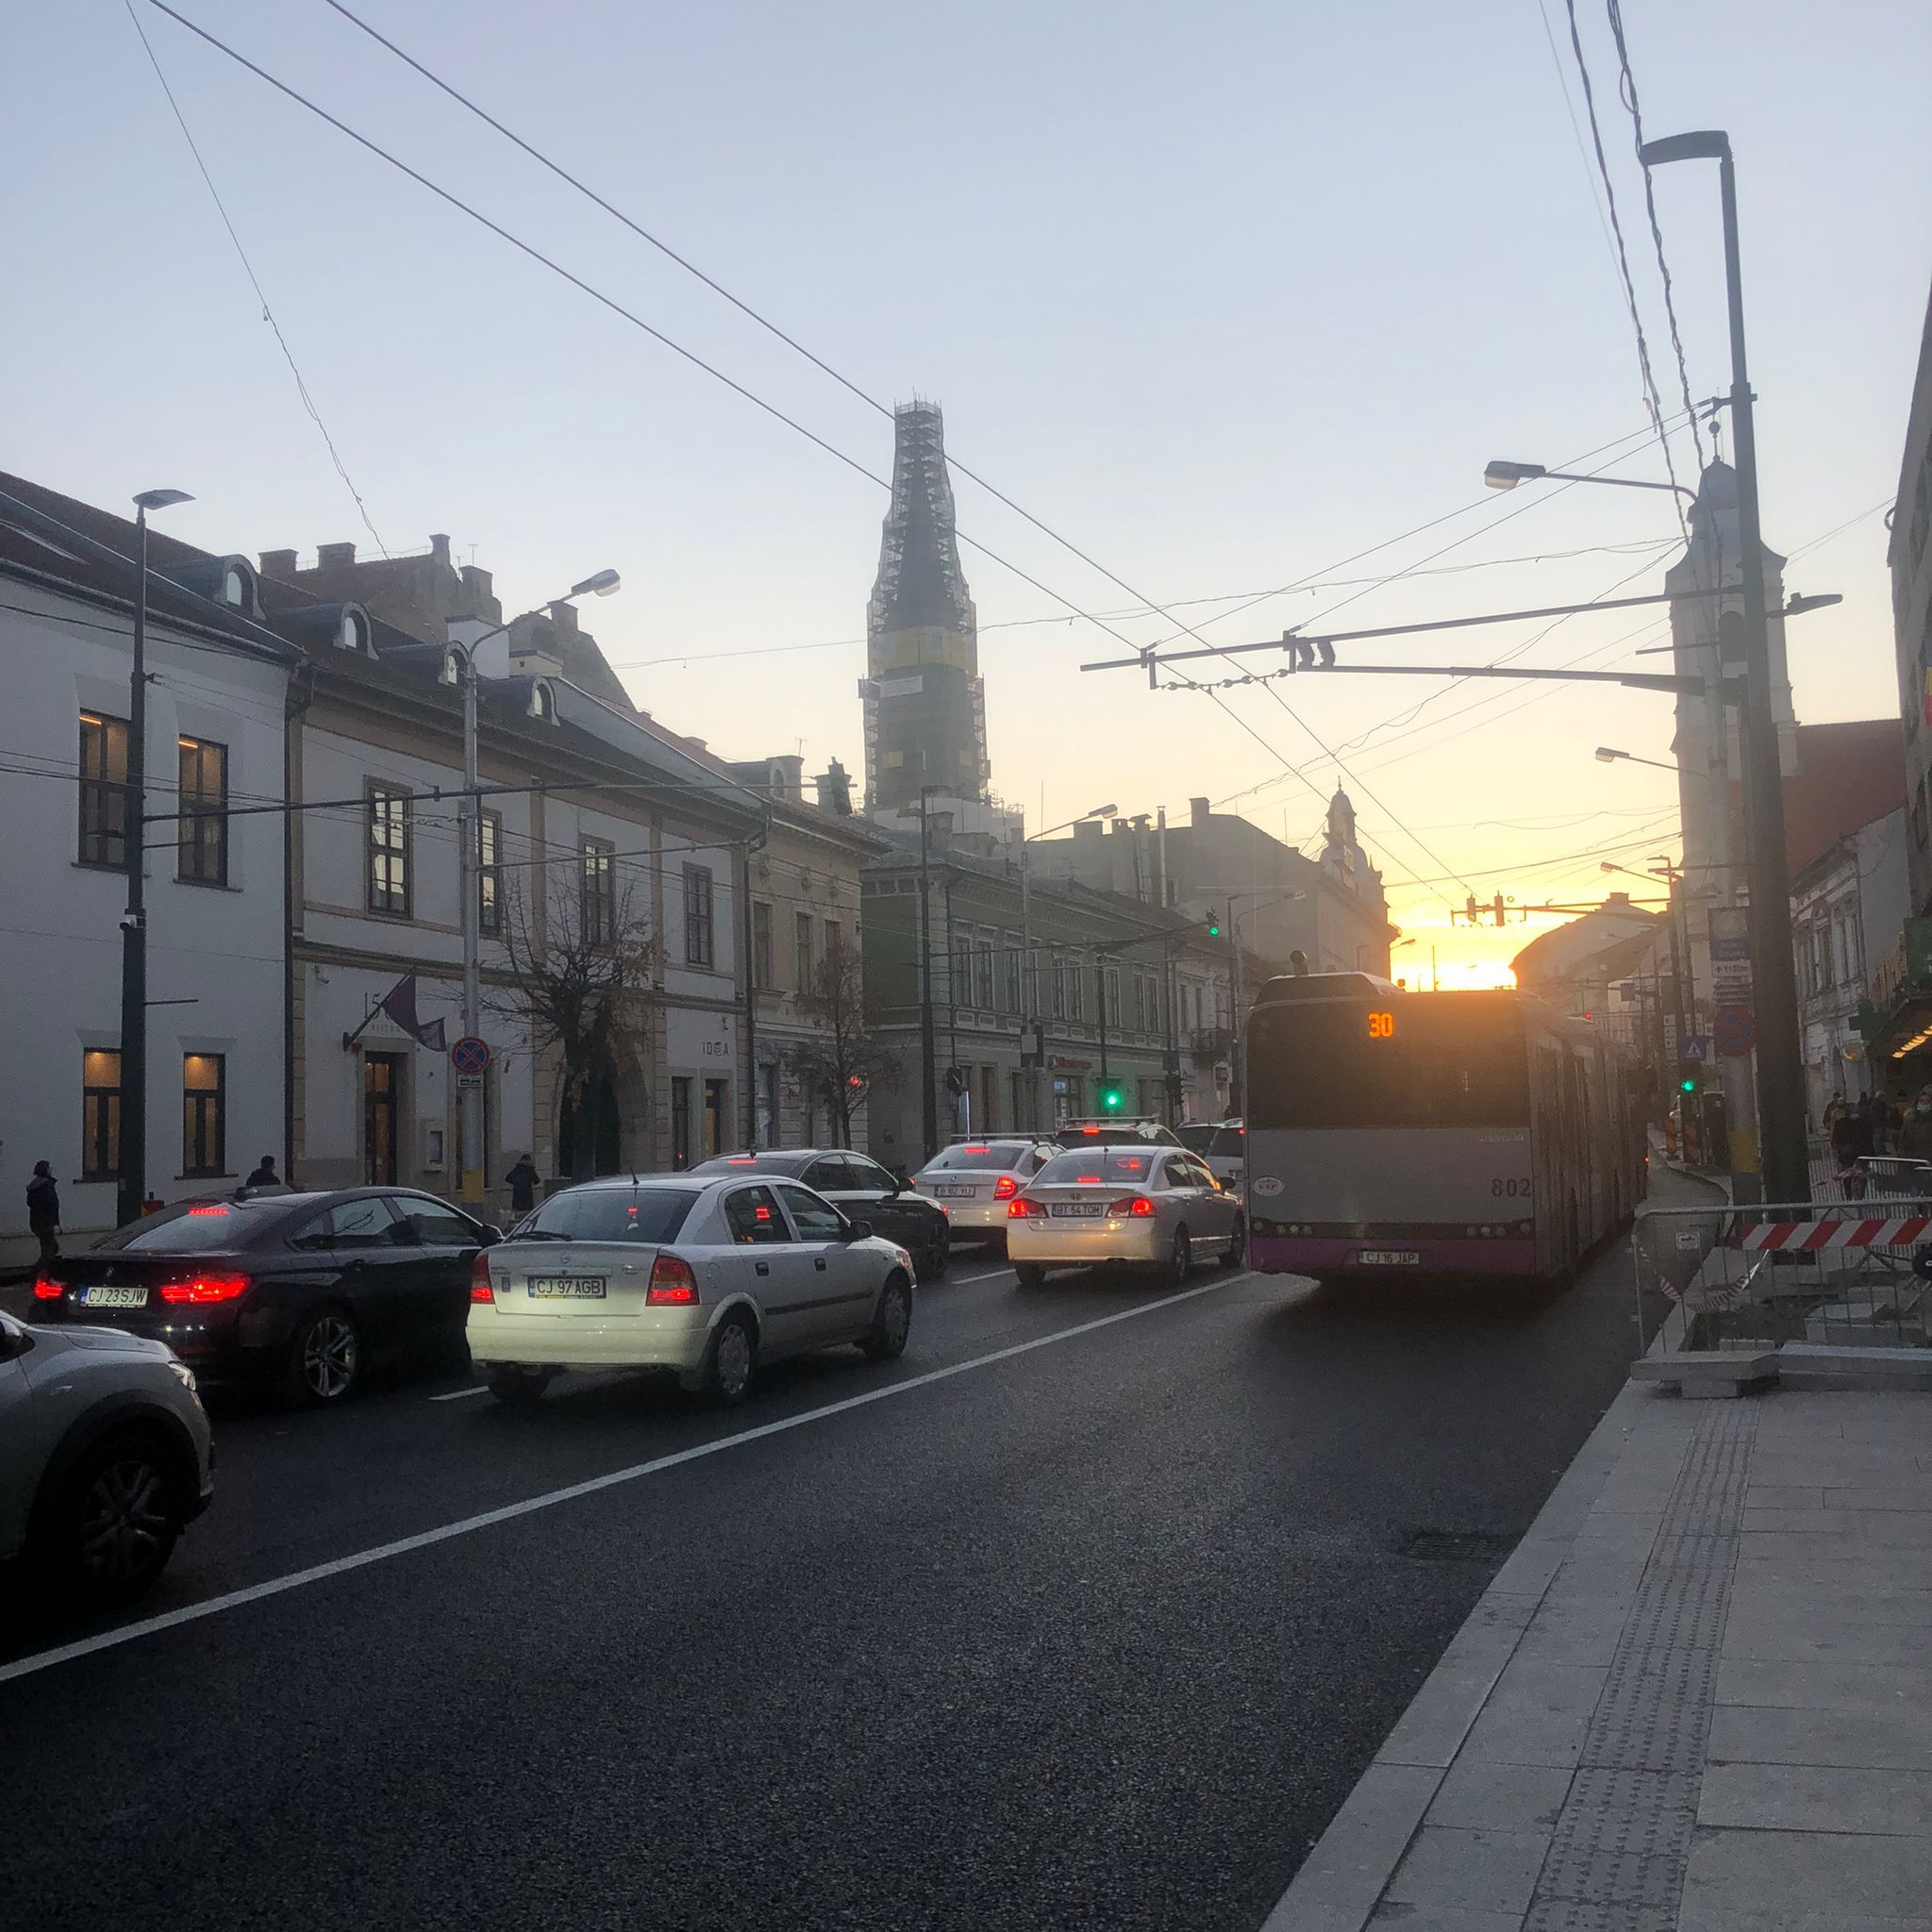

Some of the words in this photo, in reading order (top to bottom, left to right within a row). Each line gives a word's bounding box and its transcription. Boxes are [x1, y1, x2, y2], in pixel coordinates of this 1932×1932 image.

[1369, 1013, 1393, 1038] 30
[1491, 1178, 1531, 1197] 802
[1082, 1206, 1100, 1214] TOM
[1367, 1253, 1379, 1263] CJ
[1384, 1253, 1393, 1263] 16
[1397, 1253, 1415, 1263] JAP
[537, 1280, 553, 1293] CJ
[558, 1280, 573, 1293] 97
[575, 1280, 601, 1294] AGB
[89, 1289, 104, 1302] CJ
[106, 1289, 120, 1302] 23
[121, 1289, 146, 1303] SJW
